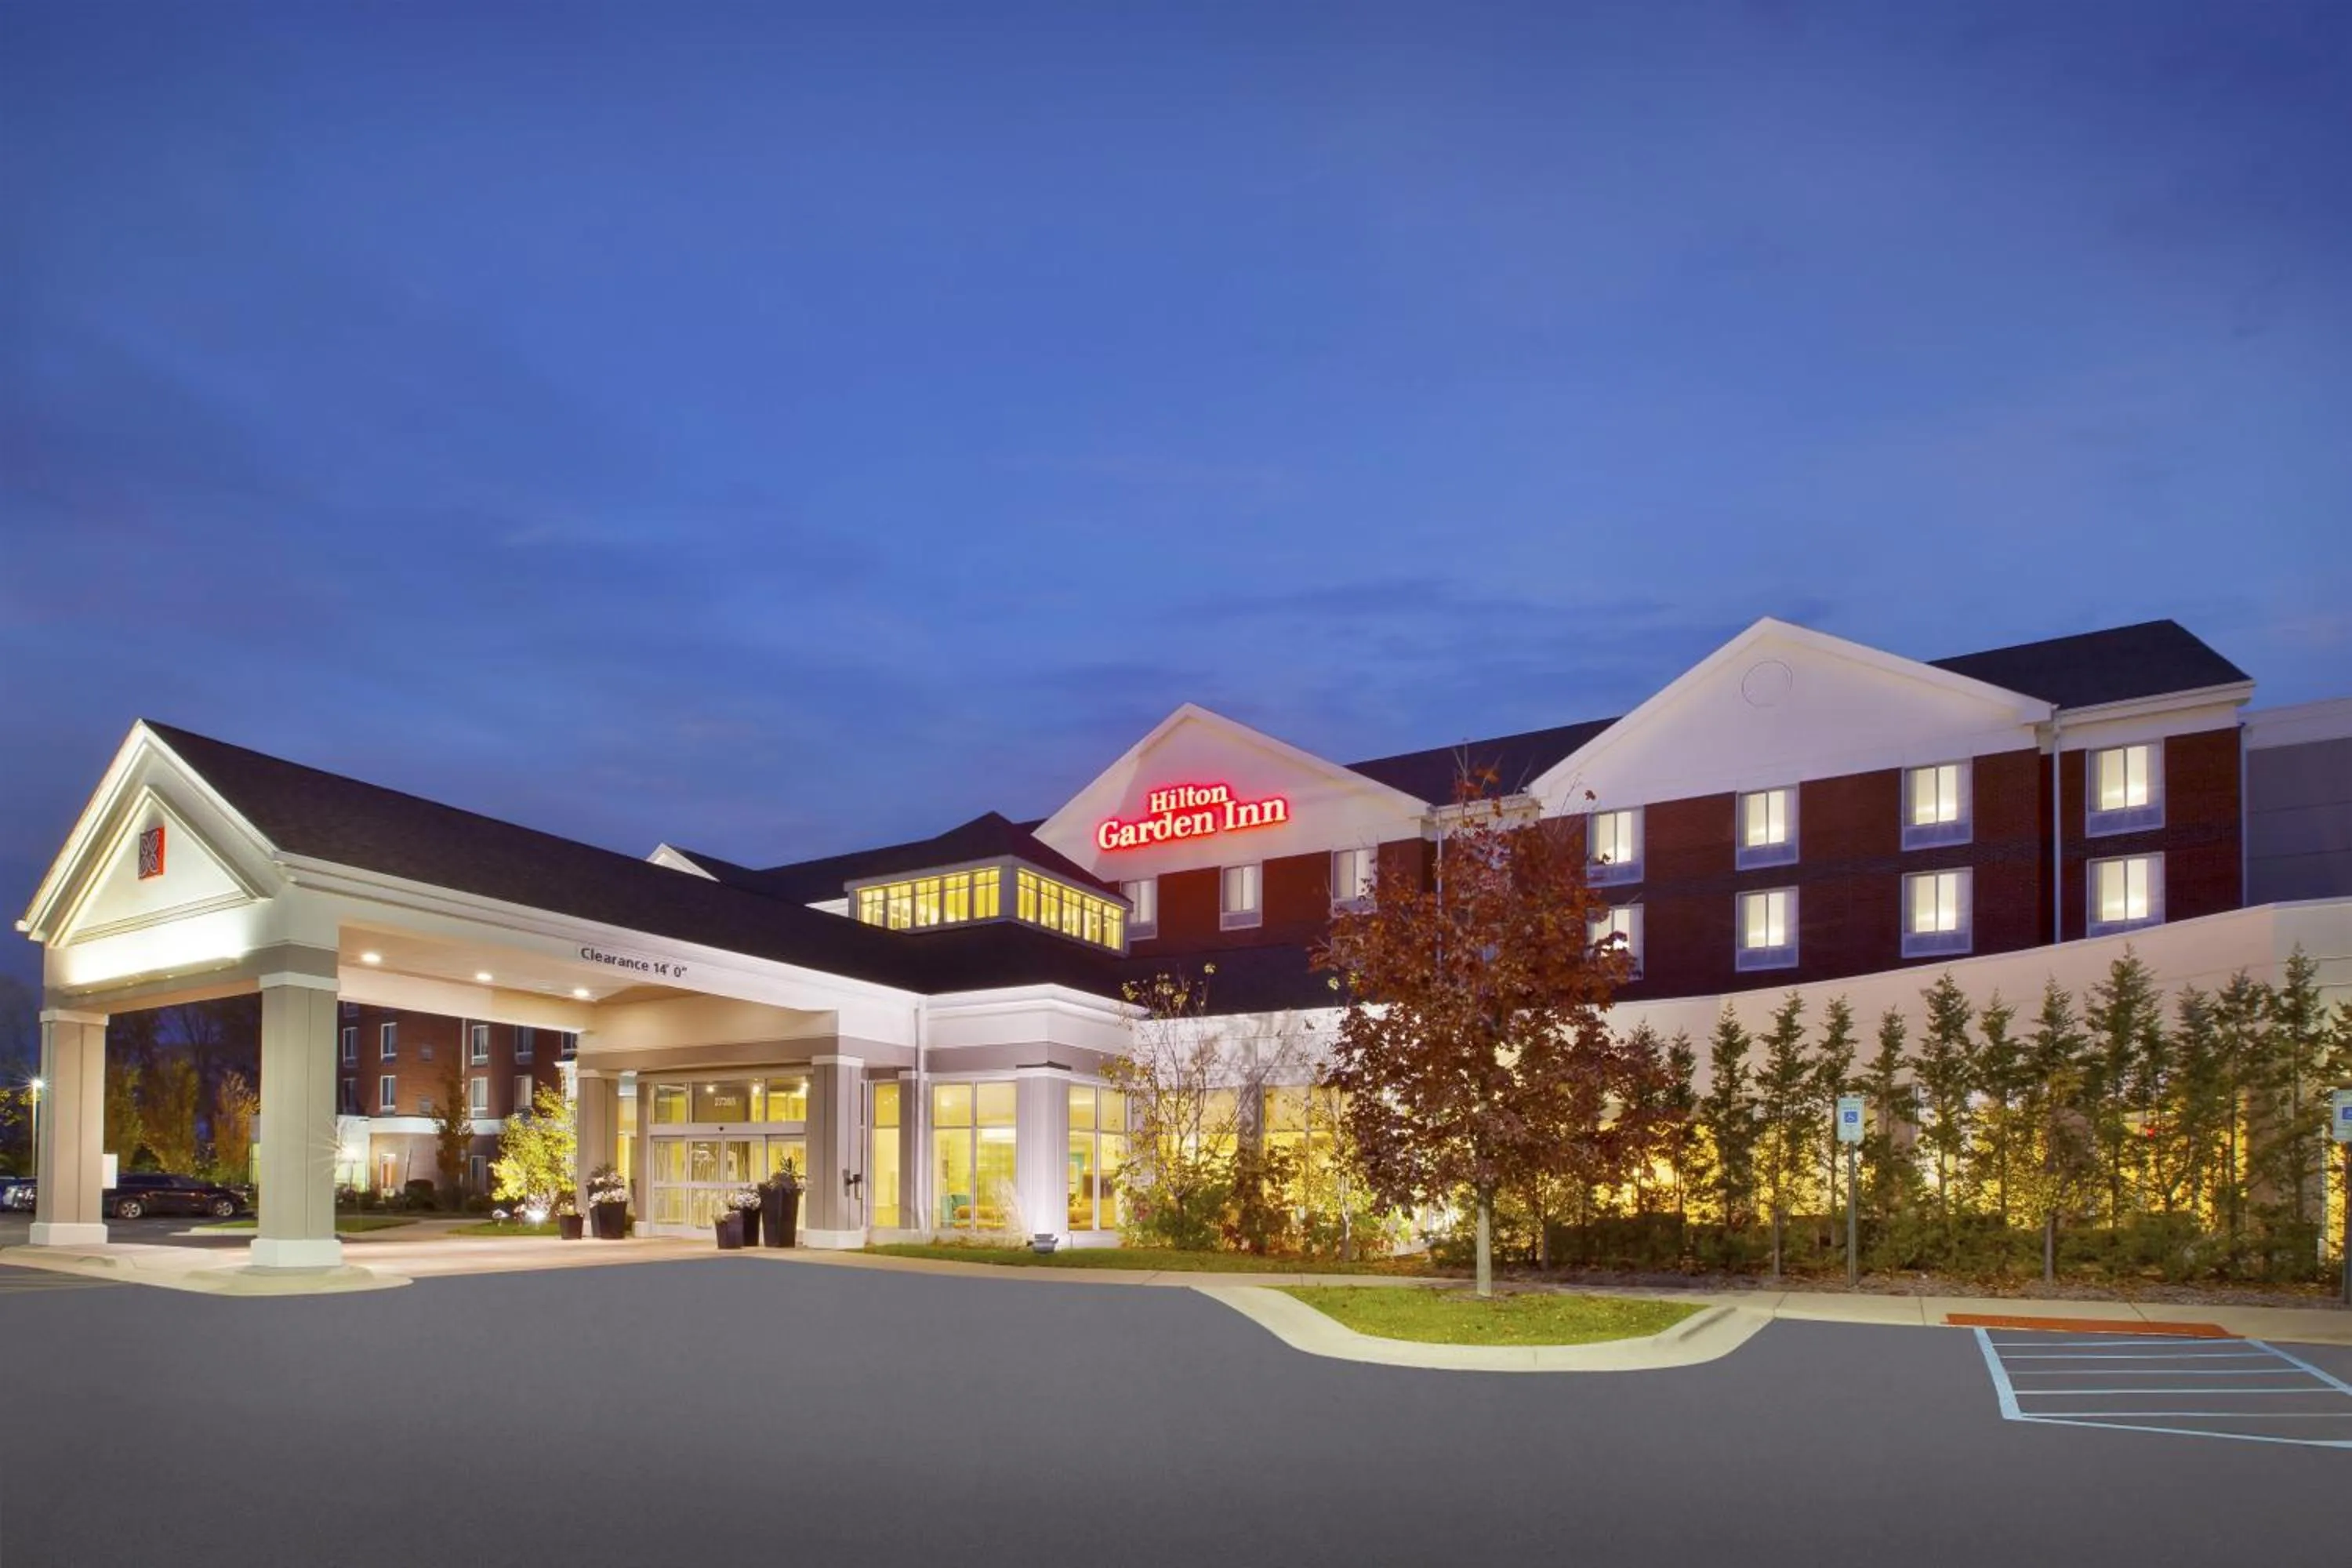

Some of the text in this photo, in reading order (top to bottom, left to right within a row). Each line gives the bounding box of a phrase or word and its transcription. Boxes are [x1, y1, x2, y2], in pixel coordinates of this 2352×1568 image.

[1149, 785, 1229, 813] Hilton
[1098, 797, 1287, 849] Garden Inn
[580, 947, 649, 971] Clearance
